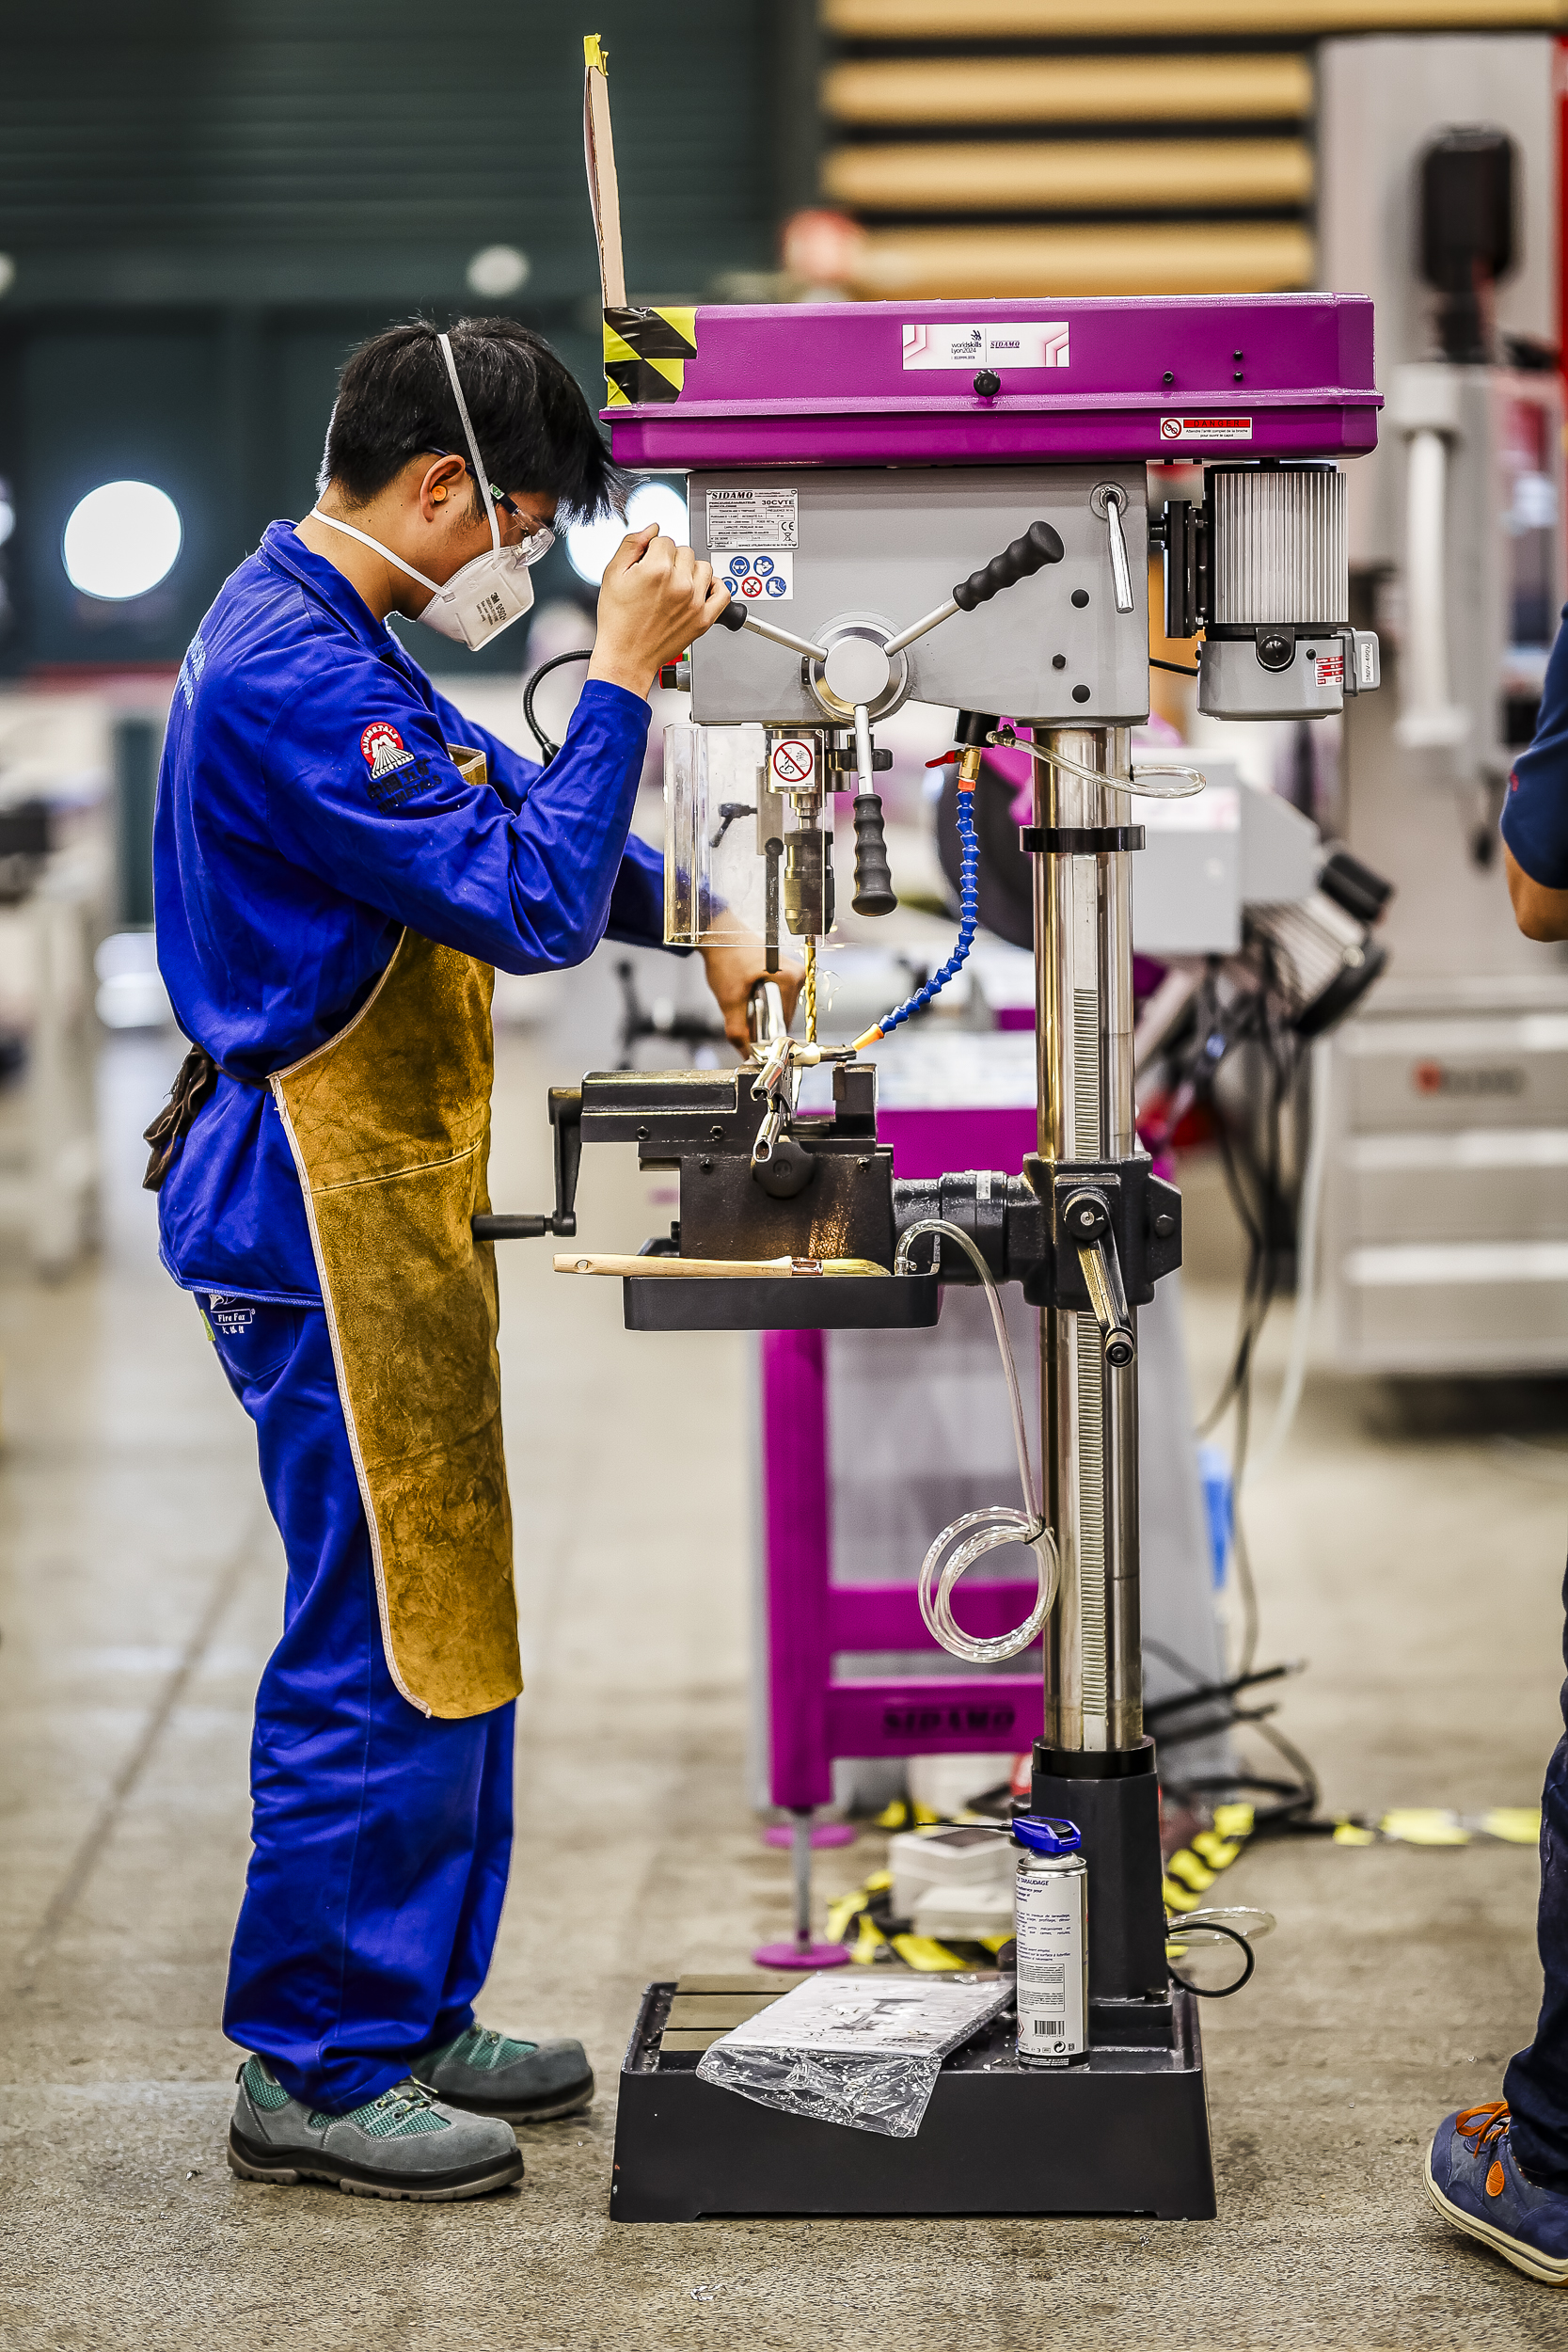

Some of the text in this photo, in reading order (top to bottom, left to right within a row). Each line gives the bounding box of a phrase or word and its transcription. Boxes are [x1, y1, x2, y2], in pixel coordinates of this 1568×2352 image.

[490, 592, 499, 604] 3M
[362, 724, 399, 755] MINMETALS
[376, 775, 442, 816] MINMETALS
[233, 1312, 245, 1321] Fox
